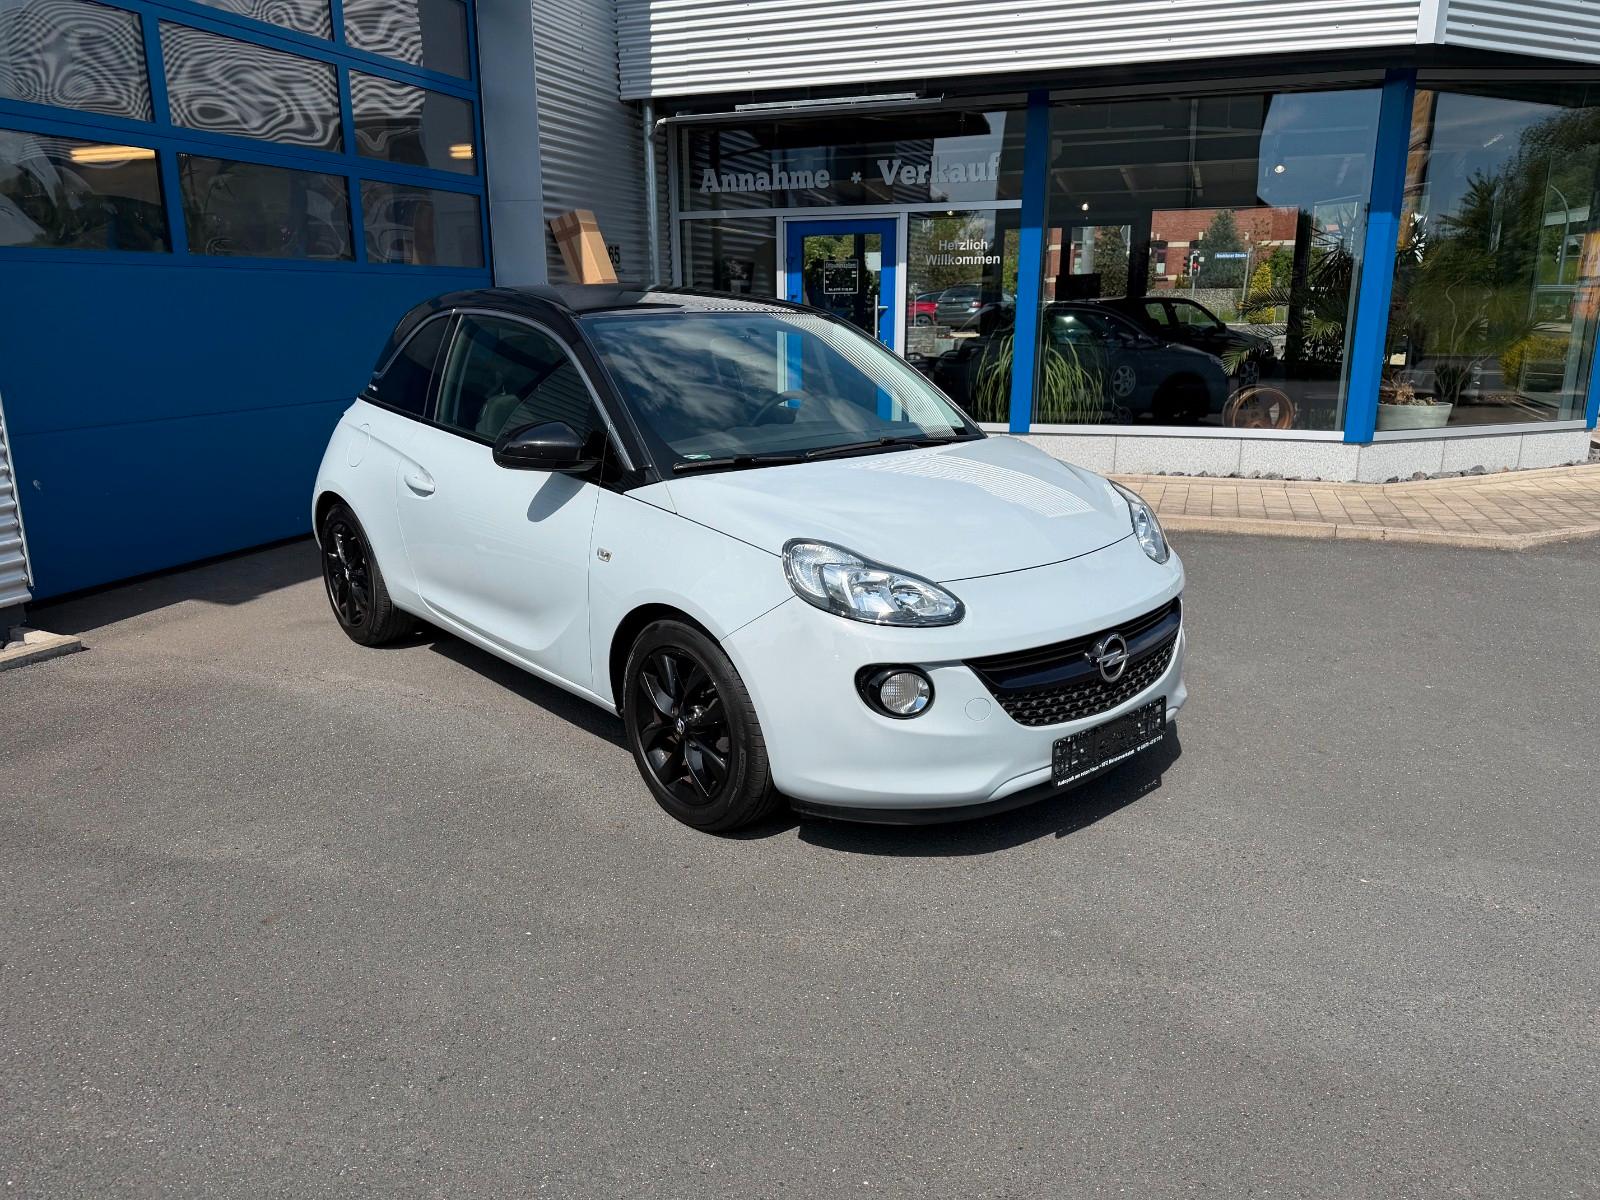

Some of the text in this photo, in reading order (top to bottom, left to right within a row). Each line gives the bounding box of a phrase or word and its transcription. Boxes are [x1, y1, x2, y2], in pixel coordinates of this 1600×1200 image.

[700, 163, 831, 193] Annahme
[877, 152, 1001, 186] Verkauf
[938, 239, 988, 251] Herzlich
[925, 254, 1001, 266] Willkommen
